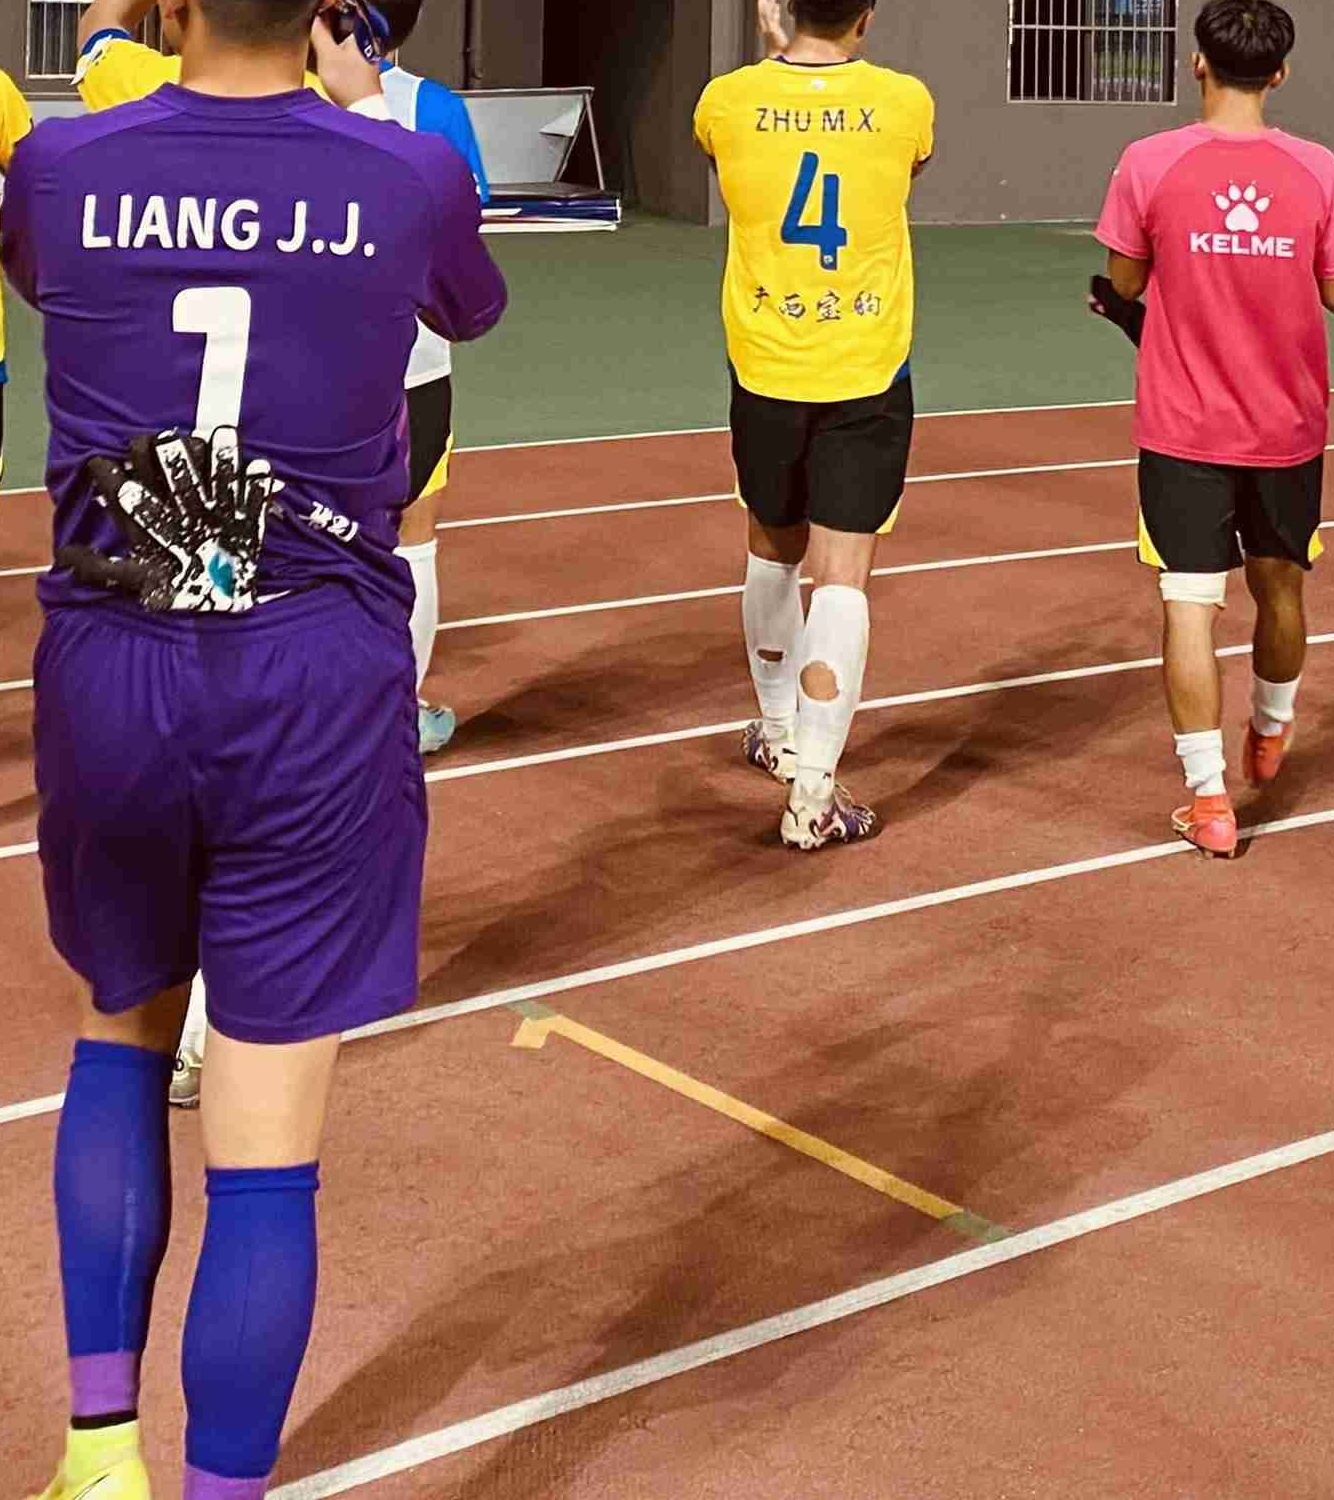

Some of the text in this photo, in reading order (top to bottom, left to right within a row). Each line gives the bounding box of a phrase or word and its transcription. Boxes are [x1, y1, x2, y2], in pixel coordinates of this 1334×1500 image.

[755, 107, 881, 133] ZHU M.X.
[81, 194, 376, 257] LIANG J.J.
[780, 151, 848, 271] 4
[1189, 231, 1296, 259] KELME
[172, 286, 252, 441] 1
